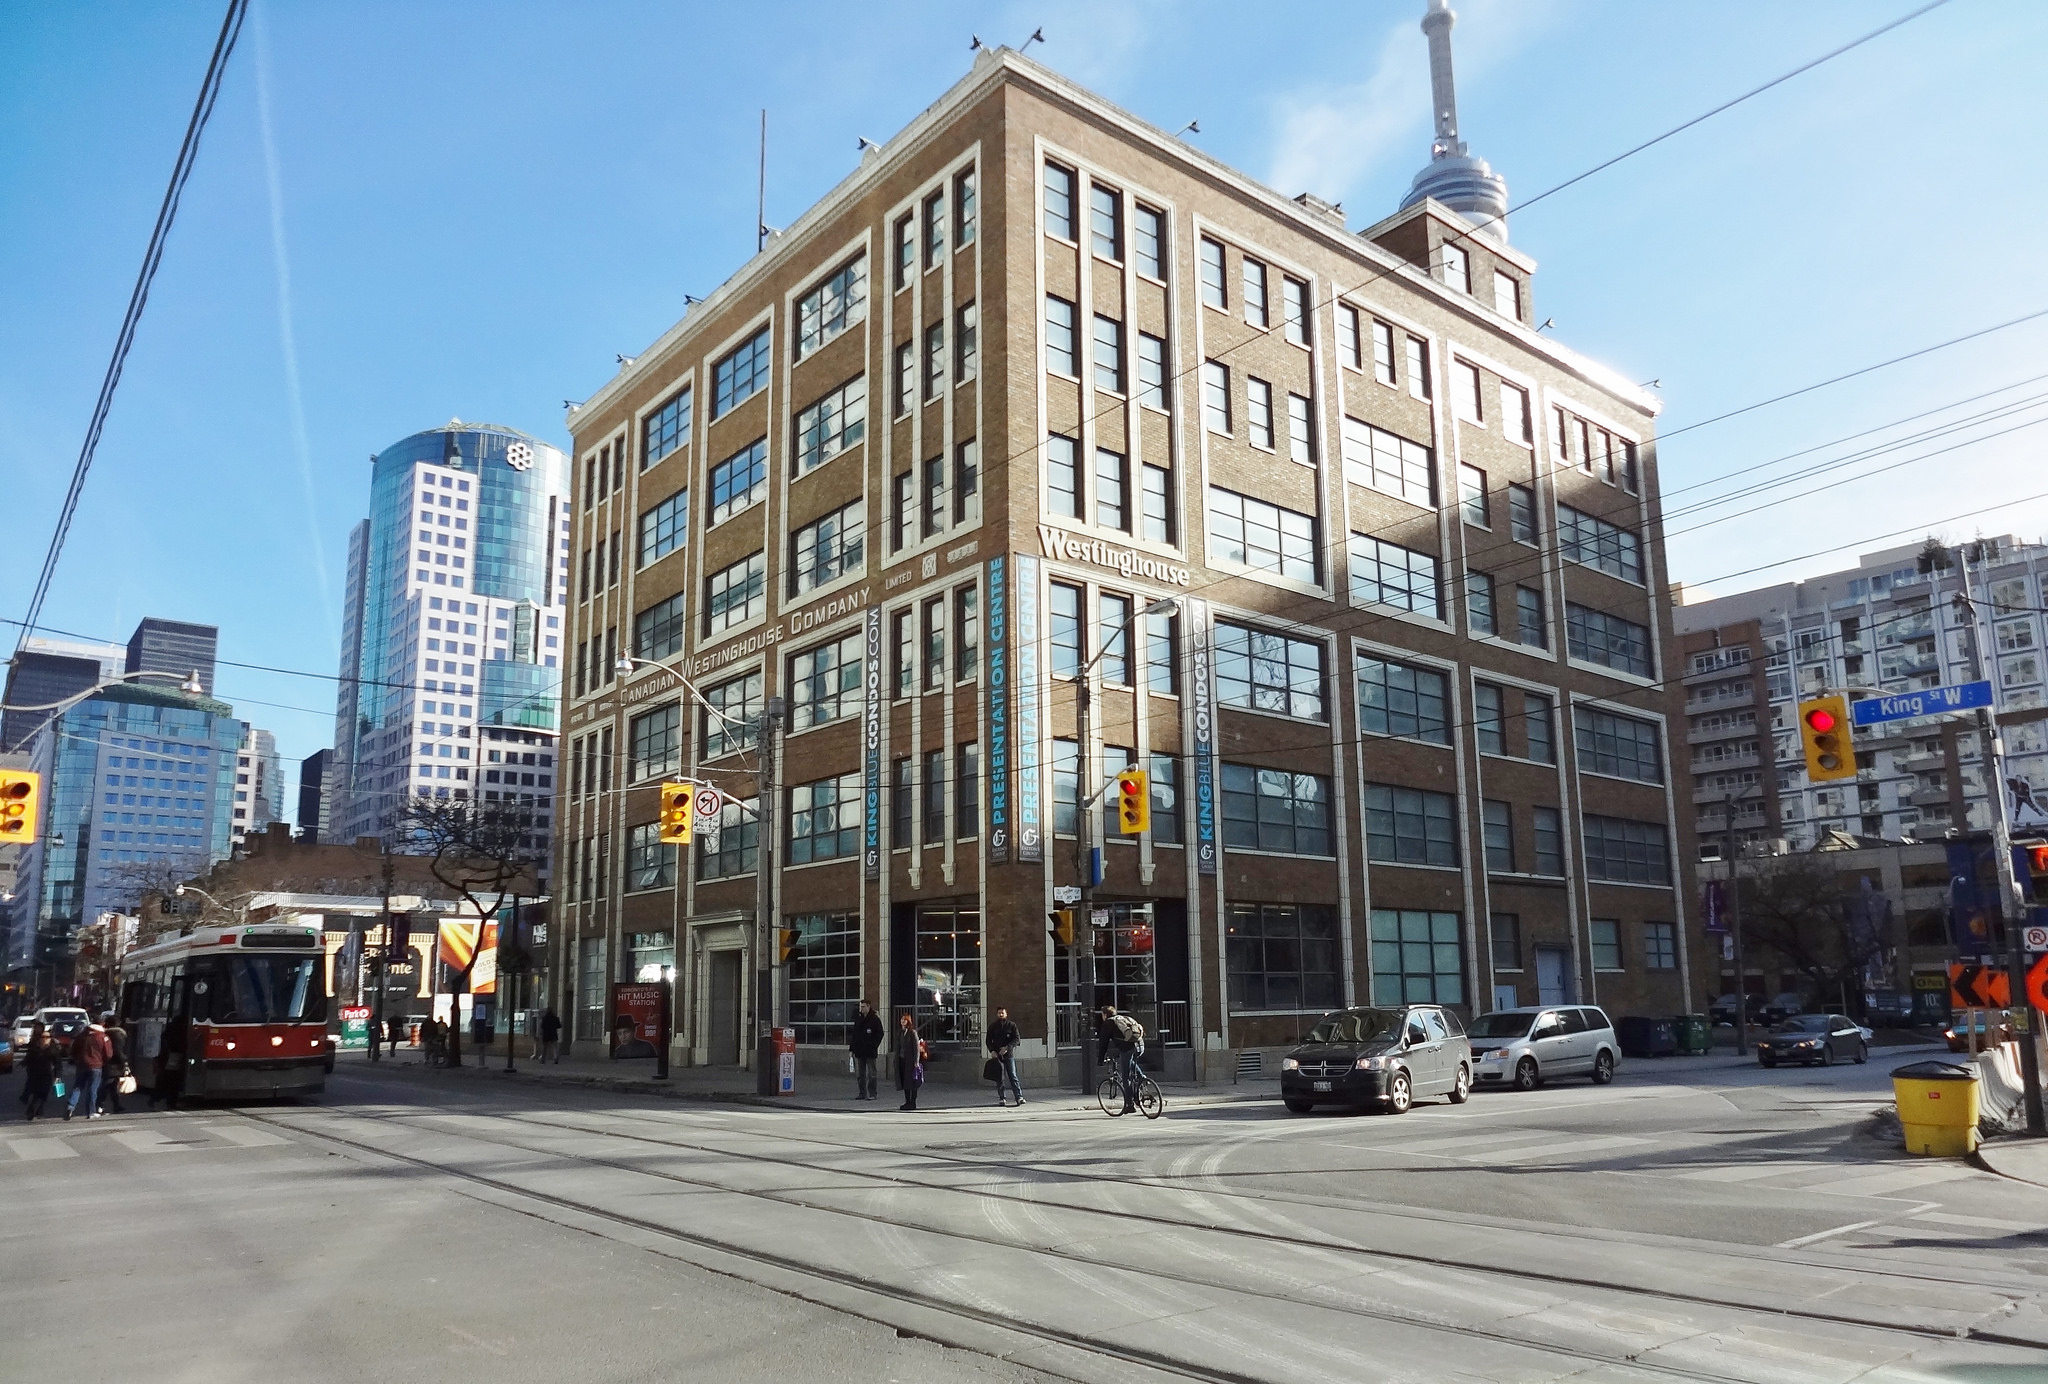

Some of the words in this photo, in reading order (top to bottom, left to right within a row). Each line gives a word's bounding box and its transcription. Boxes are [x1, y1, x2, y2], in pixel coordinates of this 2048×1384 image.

[1036, 525, 1190, 586] Westinghouse
[620, 673, 675, 707] CANADIAN
[682, 624, 784, 679] WESTINGHOUSE
[791, 586, 870, 635] COMPANY
[885, 570, 912, 590] LIMITED
[991, 557, 1003, 642] CENTRE
[1020, 557, 1036, 641] CENTRE
[867, 608, 879, 846] KINGBLUECONDOS.COM
[991, 647, 1005, 825] PRESENTATION
[1021, 647, 1038, 824] PRESENTATION
[1880, 697, 1923, 716] King
[1929, 691, 1940, 700] St
[1944, 686, 1961, 706] W
[633, 991, 660, 1000] MUSIC
